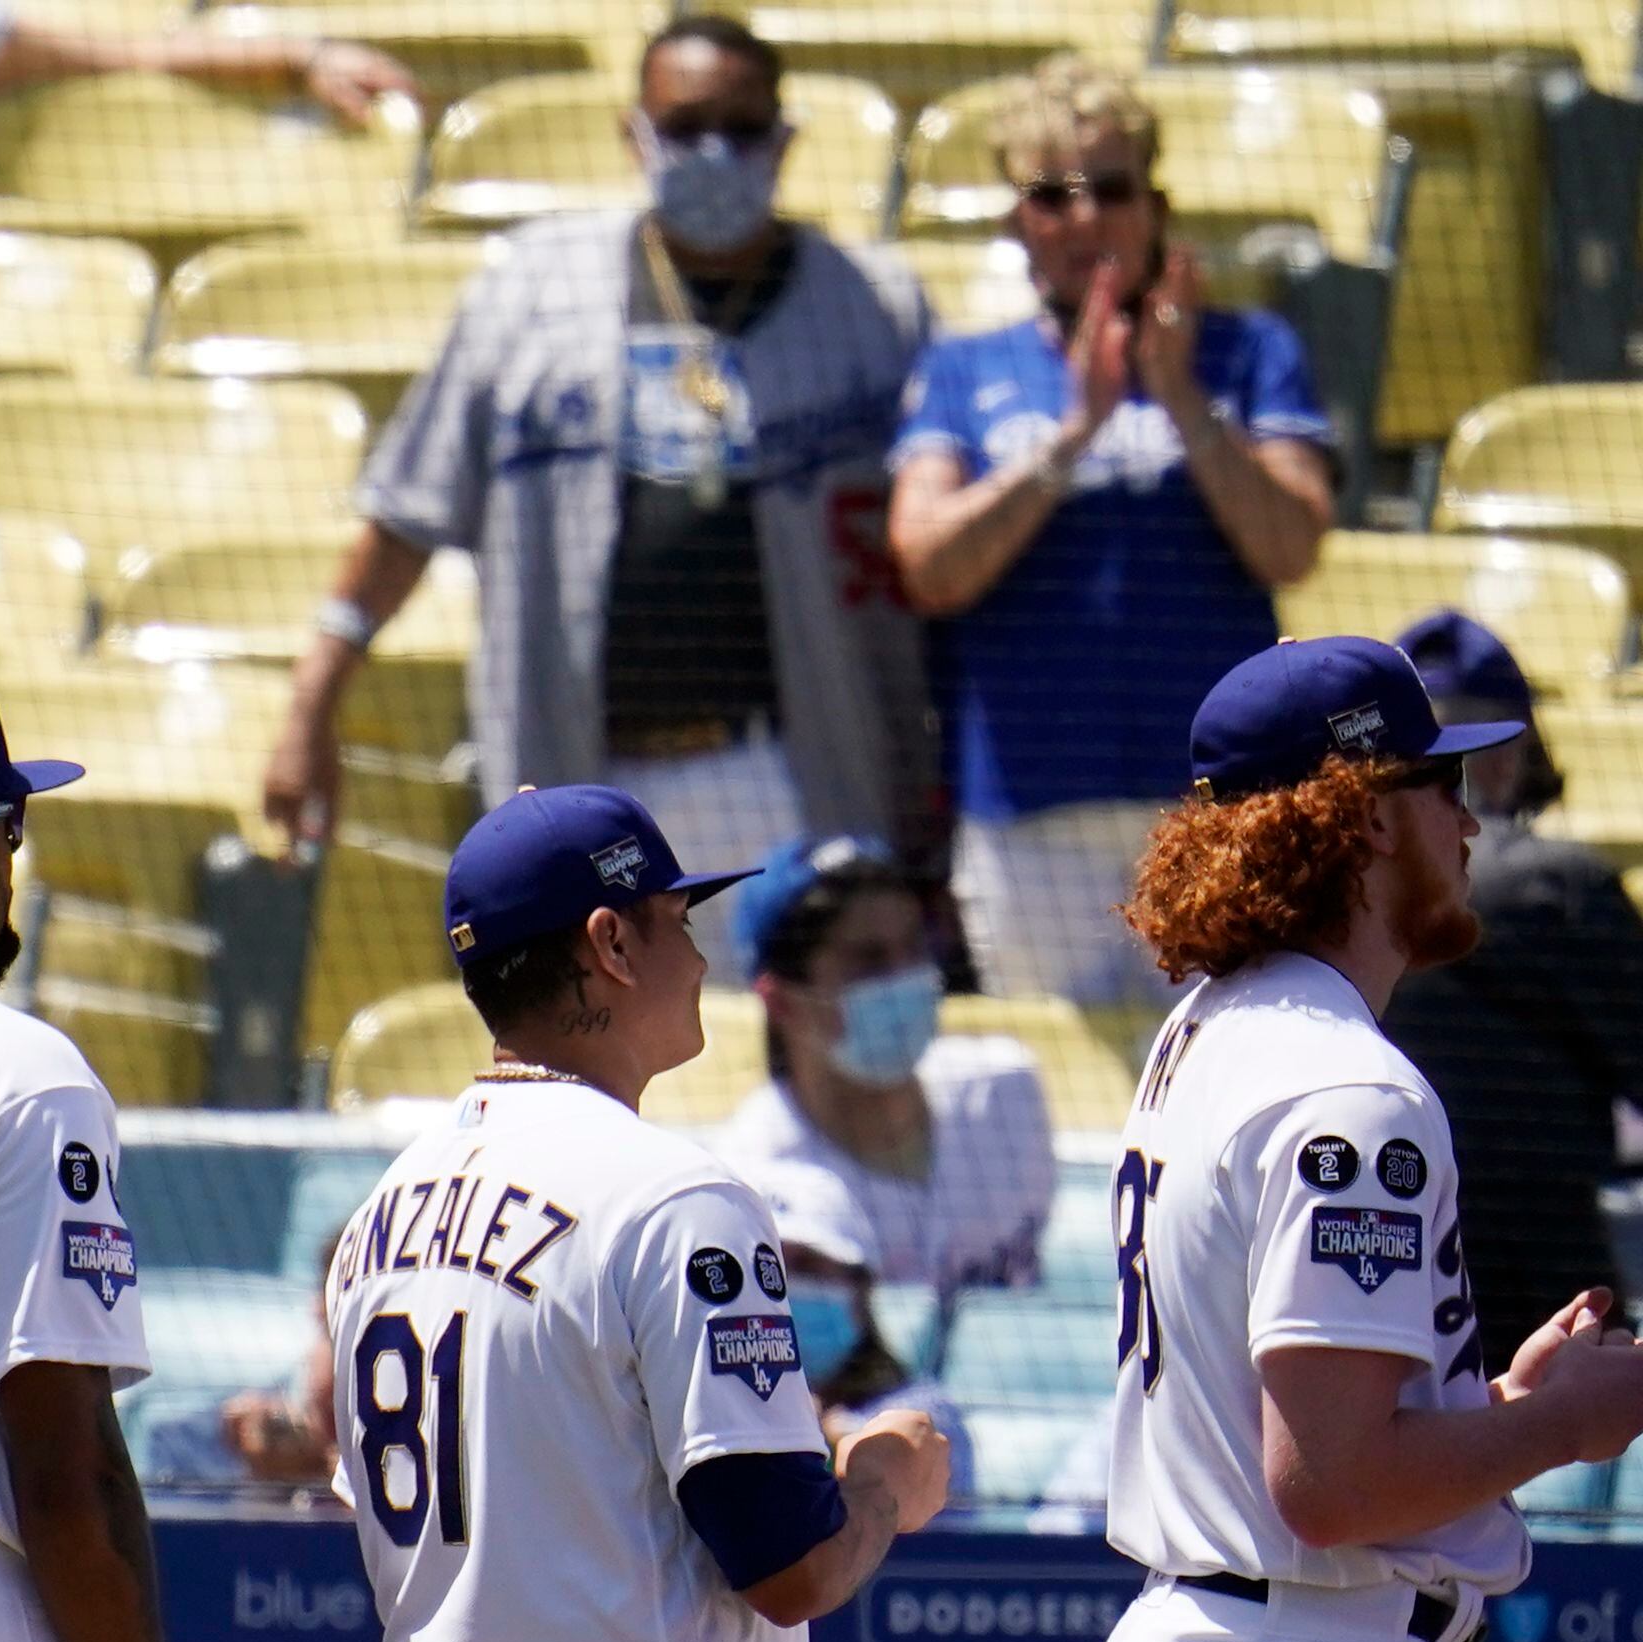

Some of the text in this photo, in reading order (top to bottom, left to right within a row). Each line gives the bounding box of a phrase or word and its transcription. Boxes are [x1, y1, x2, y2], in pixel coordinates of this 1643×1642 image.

[1308, 1143, 1347, 1154] TOMMY
[72, 1162, 87, 1191] 2
[1318, 1154, 1340, 1182] 2
[1386, 1157, 1418, 1190] 20
[1317, 1220, 1416, 1237] WORLD SERIES
[1318, 1231, 1415, 1260] CHAMPIONS
[69, 1248, 134, 1275] CHAMPIONS
[692, 1253, 727, 1268] TOMMY
[1358, 1256, 1379, 1286] LA
[706, 1265, 729, 1294] 2
[714, 1331, 756, 1342] WORLD
[716, 1340, 795, 1364] CHAMPIONS
[752, 1363, 771, 1392] LA
[355, 1310, 472, 1548] 81
[234, 1568, 366, 1632] blue
[887, 1590, 1119, 1638] DODGERS
